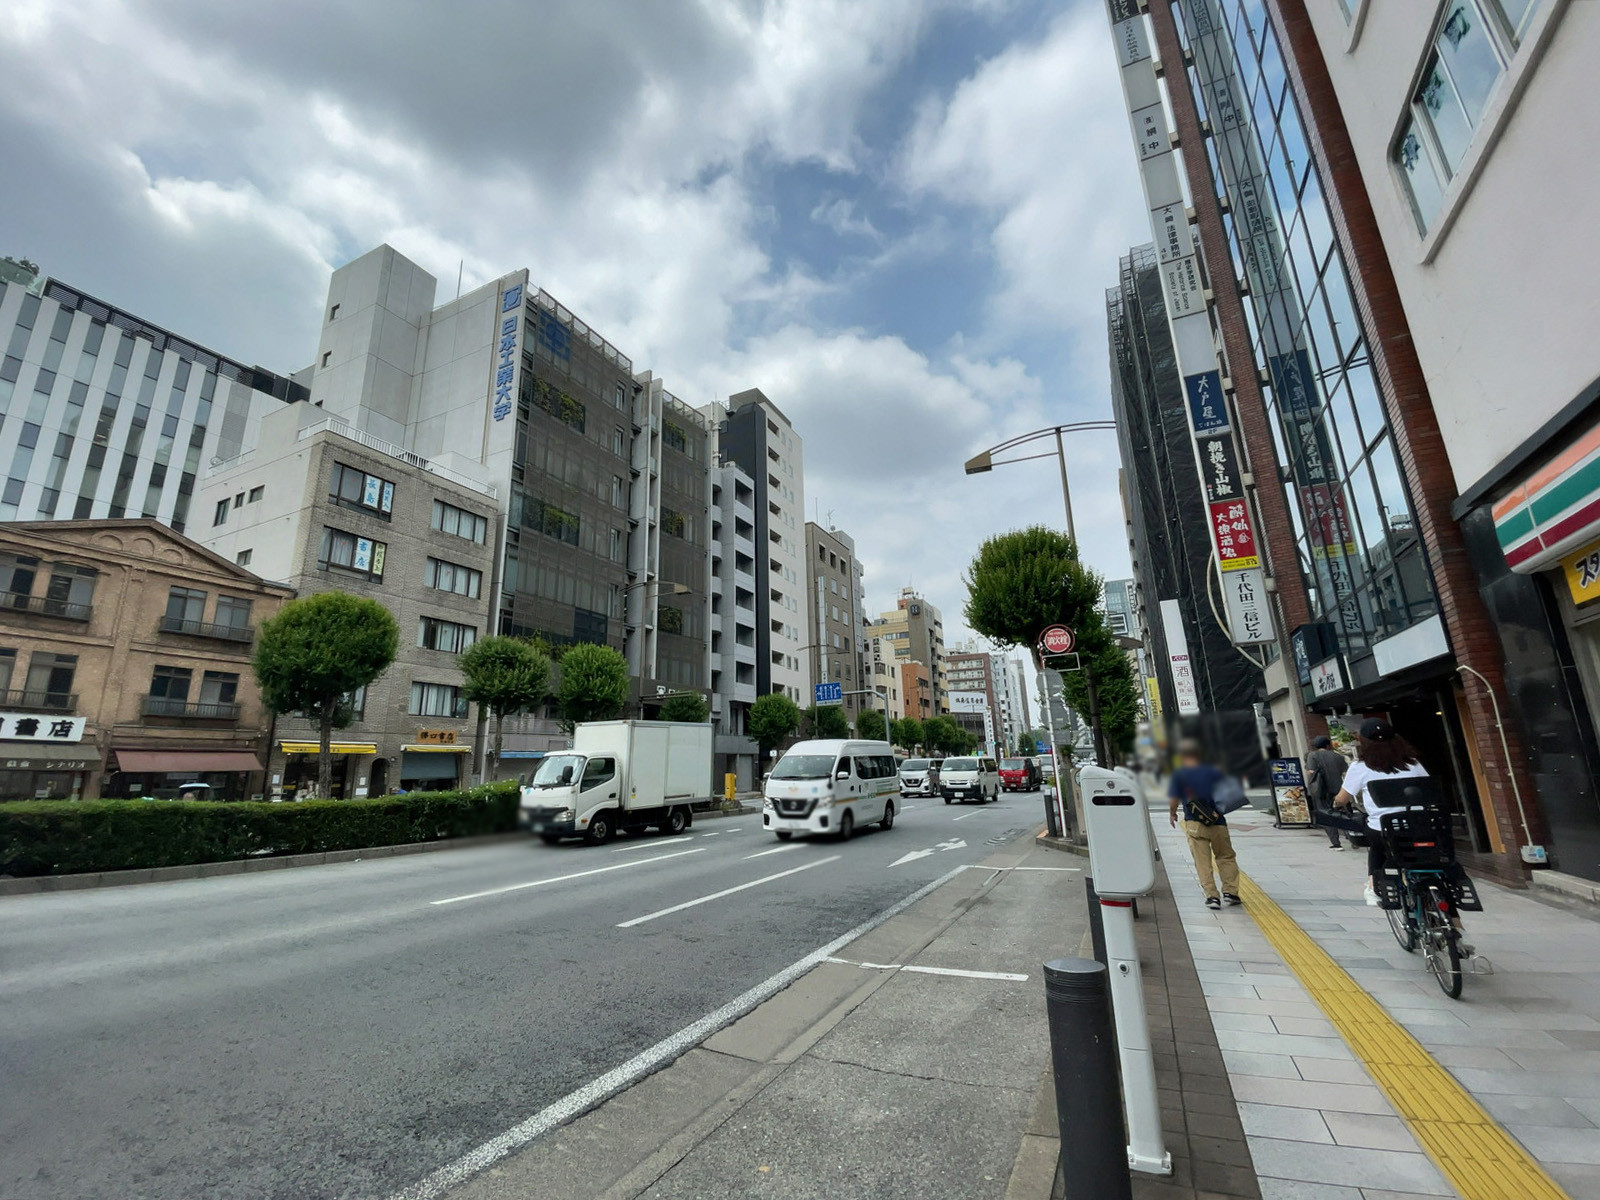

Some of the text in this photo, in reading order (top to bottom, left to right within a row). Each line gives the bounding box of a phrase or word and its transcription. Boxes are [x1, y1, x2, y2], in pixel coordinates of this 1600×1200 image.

[494, 315, 518, 421] 日本工業大学
[1198, 375, 1216, 418] 大戸屋
[1216, 513, 1237, 557] 大衆酒場
[1236, 573, 1262, 640] 千代田三信ビル
[1176, 666, 1189, 677] 酒
[0, 717, 74, 737] 書店
